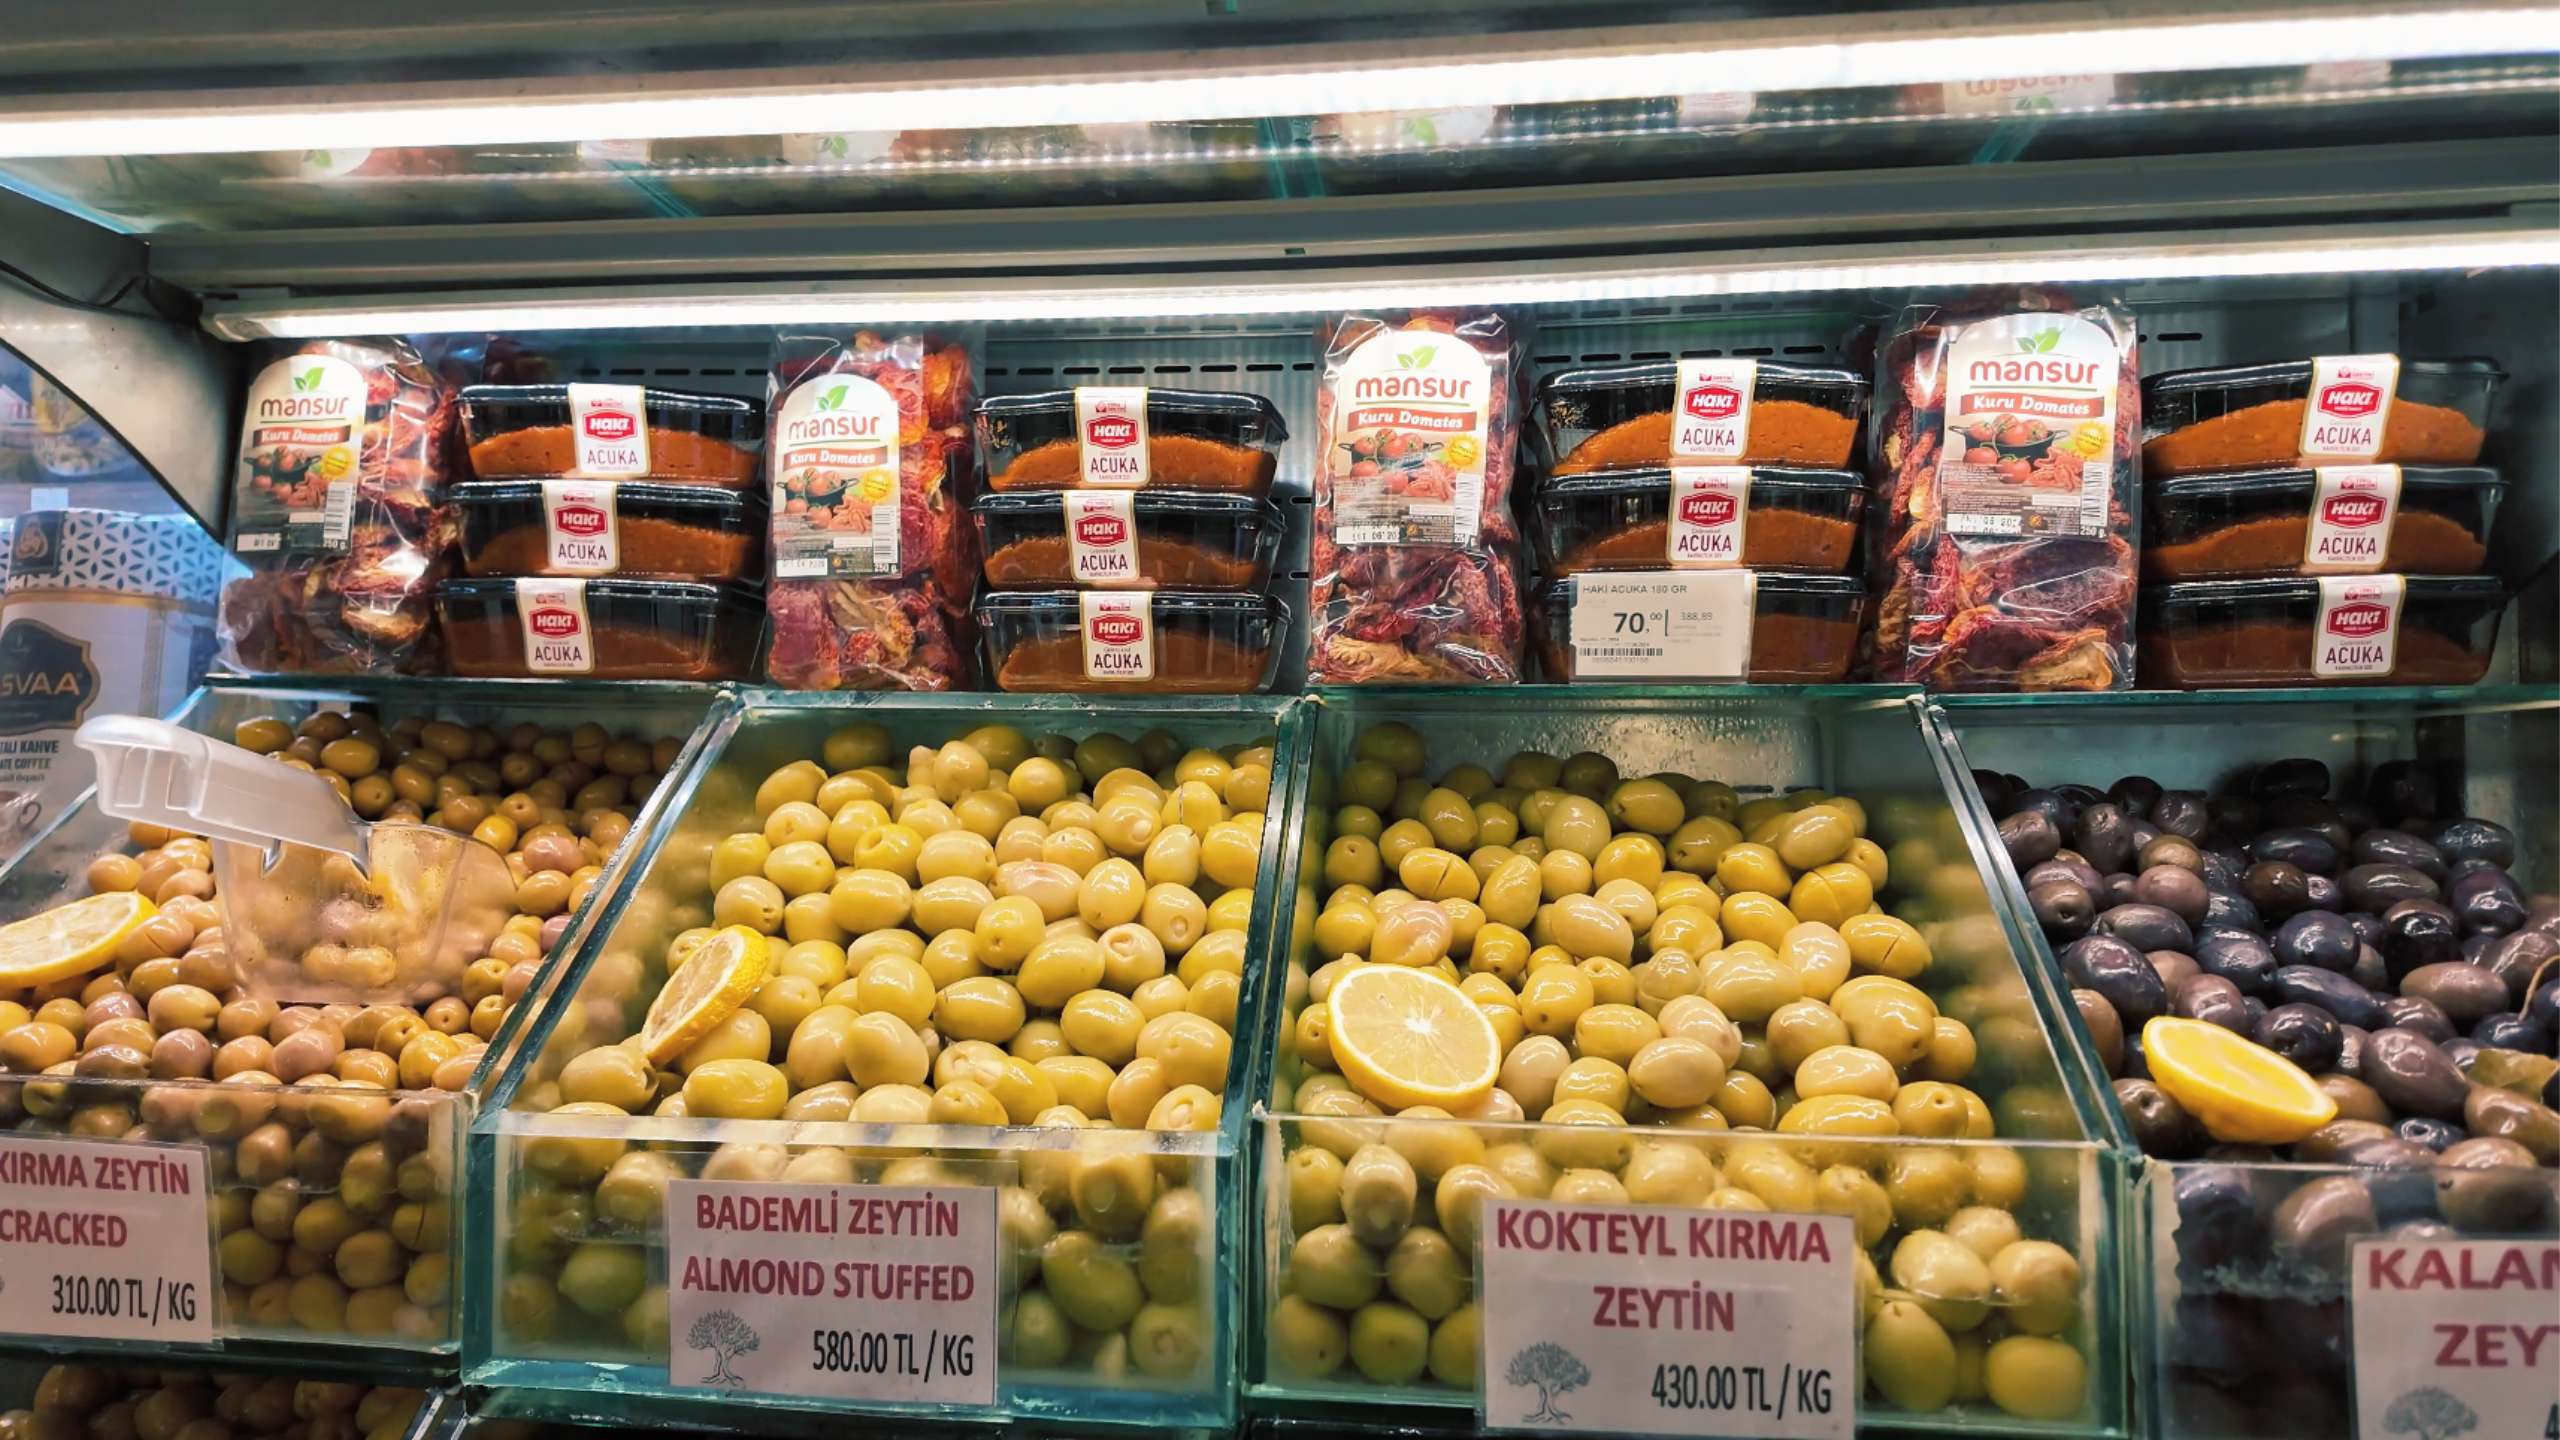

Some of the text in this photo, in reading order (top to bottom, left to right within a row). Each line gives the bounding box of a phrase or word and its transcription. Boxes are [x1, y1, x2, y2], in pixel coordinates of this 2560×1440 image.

[1970, 360, 2099, 384] mansur
[1356, 377, 1471, 398] mansur
[261, 396, 349, 417] mansur
[1973, 395, 2090, 415] Kuru Domates
[789, 415, 880, 440] mansur
[1358, 410, 1463, 429] Kuru Domates
[1682, 428, 1736, 446] ACUKA
[2313, 426, 2372, 446] ACUKA
[587, 449, 638, 465] ACUKA
[790, 452, 817, 465] Kuru
[1090, 457, 1139, 474] ACUKA
[558, 543, 608, 561] ACUKA
[1678, 533, 1732, 552] ACUKA
[2318, 537, 2377, 555] ACUKA
[1080, 554, 1128, 571] ACUKA
[1611, 584, 1648, 594] ACUKA
[1670, 584, 1688, 594] GR
[534, 645, 583, 662] ACUKA
[1094, 653, 1143, 669] ACUKA
[2325, 645, 2384, 665] ACUKA
[20, 740, 60, 753] KAHVE
[94, 1153, 190, 1194] ZEYTİN
[696, 1190, 959, 1237] BADEMLİ ZEYTİN
[0, 1209, 128, 1248] CRACKED
[1497, 1208, 1831, 1263] KOKTEYL KIRMA
[681, 1255, 974, 1301] ALMOND STUFFED
[52, 1274, 120, 1317] 310.00
[1592, 1280, 1735, 1332] ZEYTİN
[813, 1330, 888, 1374] 580.00
[1651, 1364, 1737, 1410] 430.00
